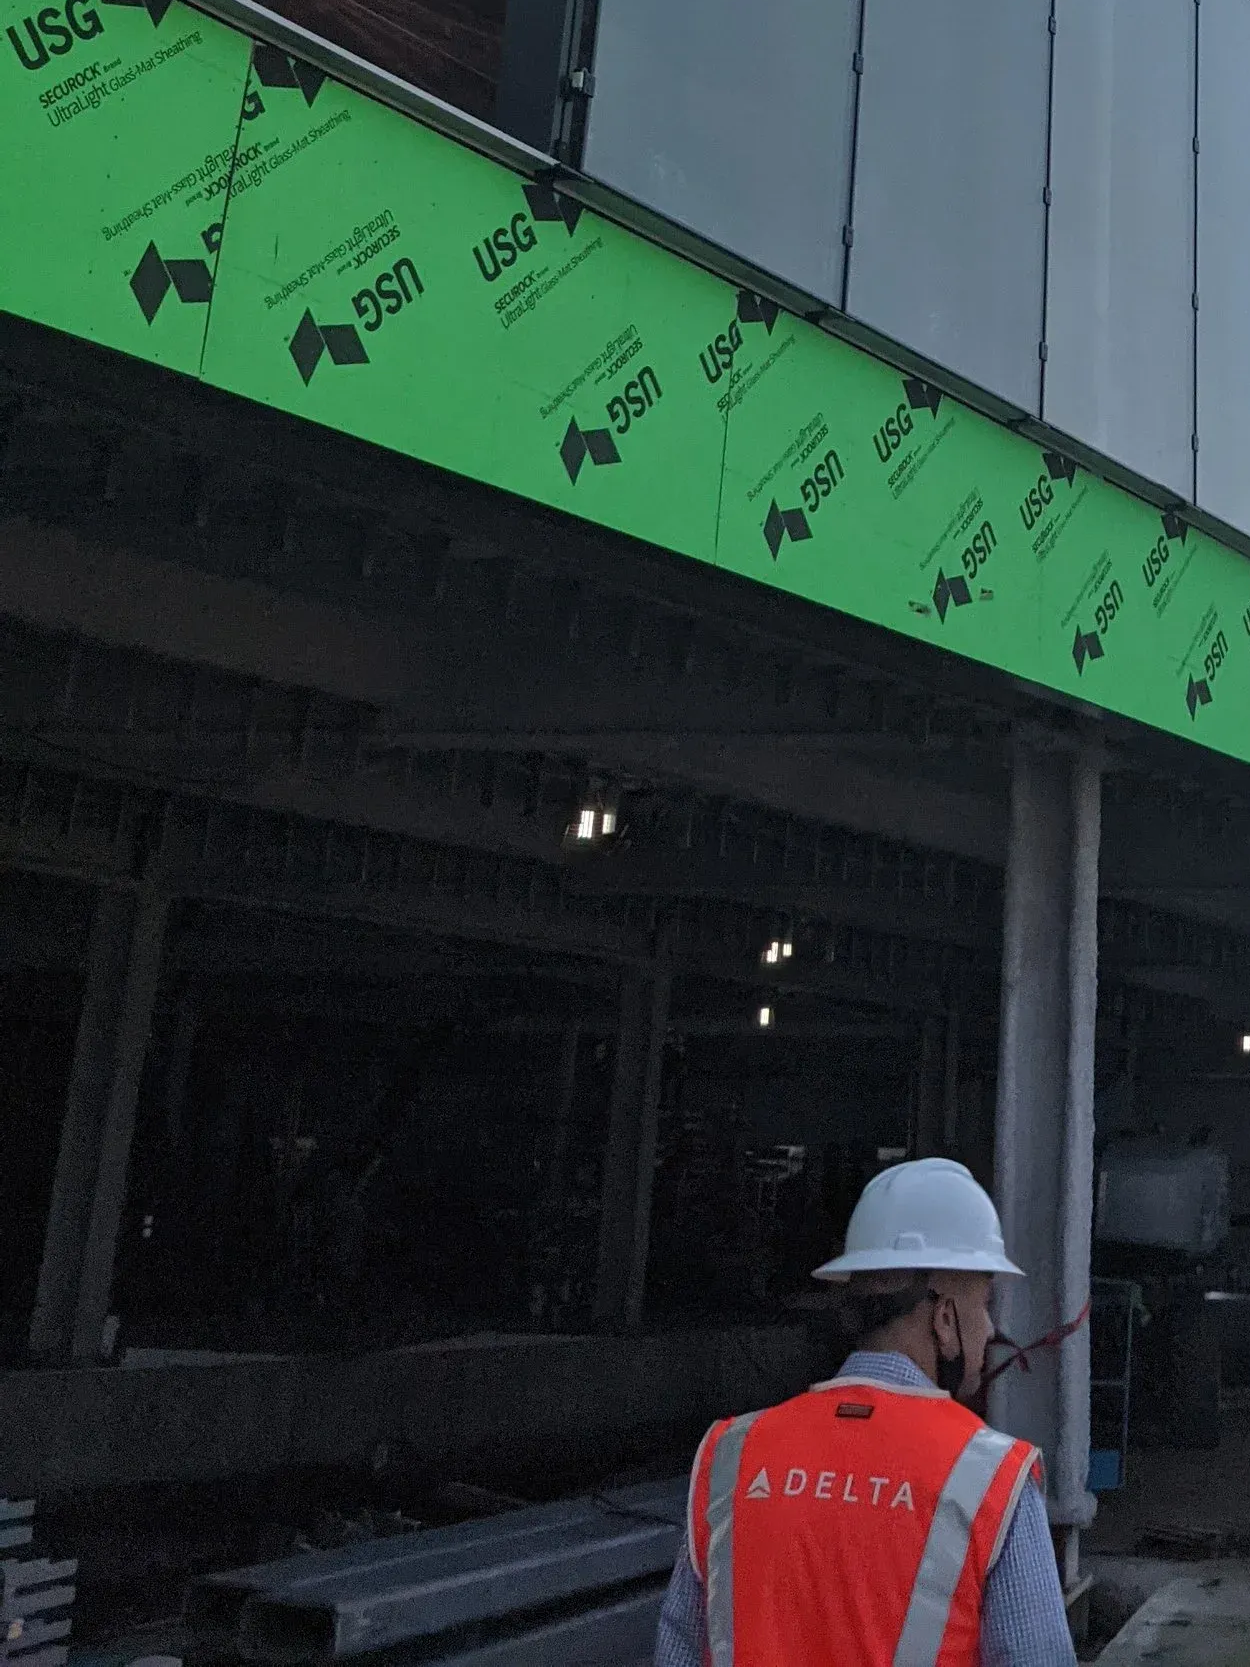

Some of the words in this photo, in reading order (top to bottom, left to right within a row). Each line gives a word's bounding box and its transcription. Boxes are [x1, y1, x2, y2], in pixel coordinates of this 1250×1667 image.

[39, 62, 101, 109] SECUROCK
[47, 81, 111, 127] UltraLight
[154, 31, 203, 65] Sheathing
[309, 109, 352, 143] Sheathing
[101, 202, 153, 241] Sheathing
[348, 209, 394, 252] UltraLight
[353, 225, 401, 270] SECUROCK
[472, 212, 538, 282] USG
[264, 274, 309, 310] Sheathing
[351, 257, 425, 332] USG
[494, 270, 535, 314] SECUROCK
[606, 365, 663, 434] USG
[873, 403, 914, 463] USG
[800, 449, 845, 513] USG
[1019, 474, 1054, 531] USG
[961, 520, 998, 579] USG
[1141, 535, 1170, 588] USG
[1095, 579, 1124, 635] USG
[1204, 630, 1229, 682] USG
[784, 1468, 914, 1511] DELTA
